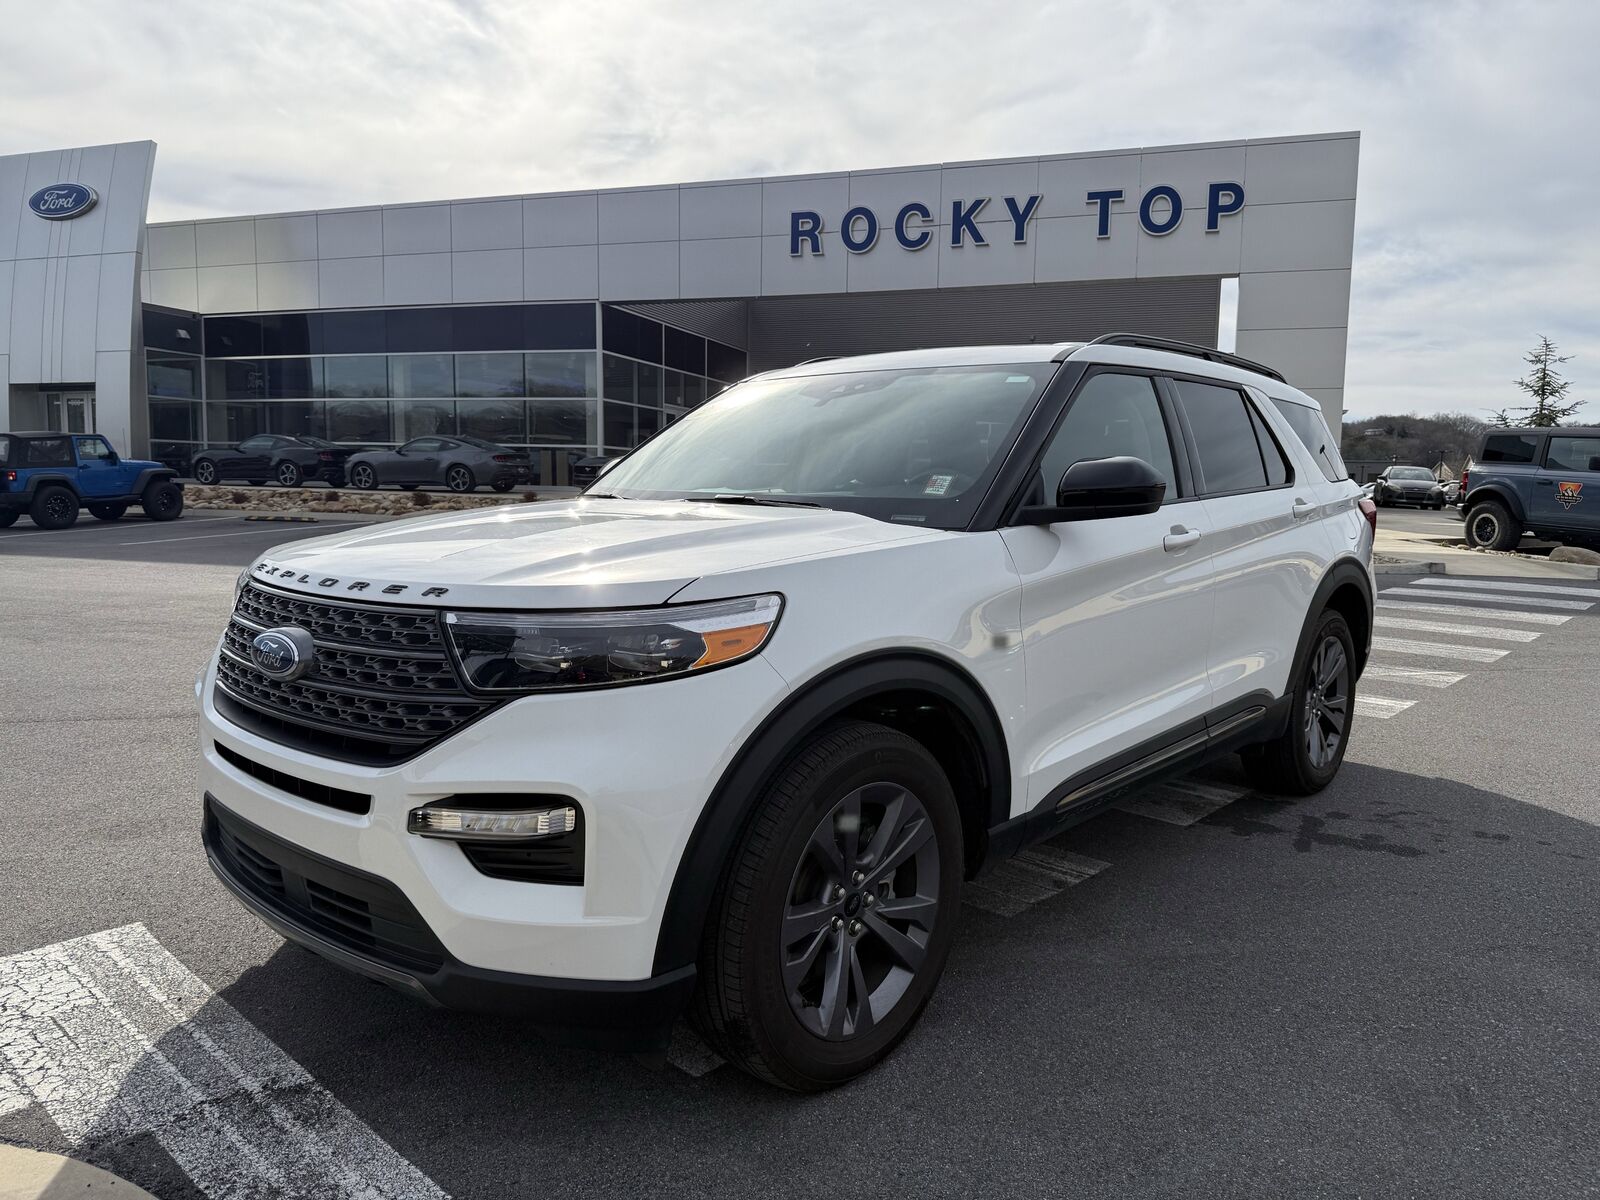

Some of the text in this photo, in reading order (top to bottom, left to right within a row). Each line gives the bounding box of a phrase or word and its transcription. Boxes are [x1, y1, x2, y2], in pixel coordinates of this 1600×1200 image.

[40, 190, 77, 210] Ford
[790, 181, 1246, 256] ROCKY TOP
[255, 563, 450, 598] EXPLORER
[257, 641, 284, 667] Ford
